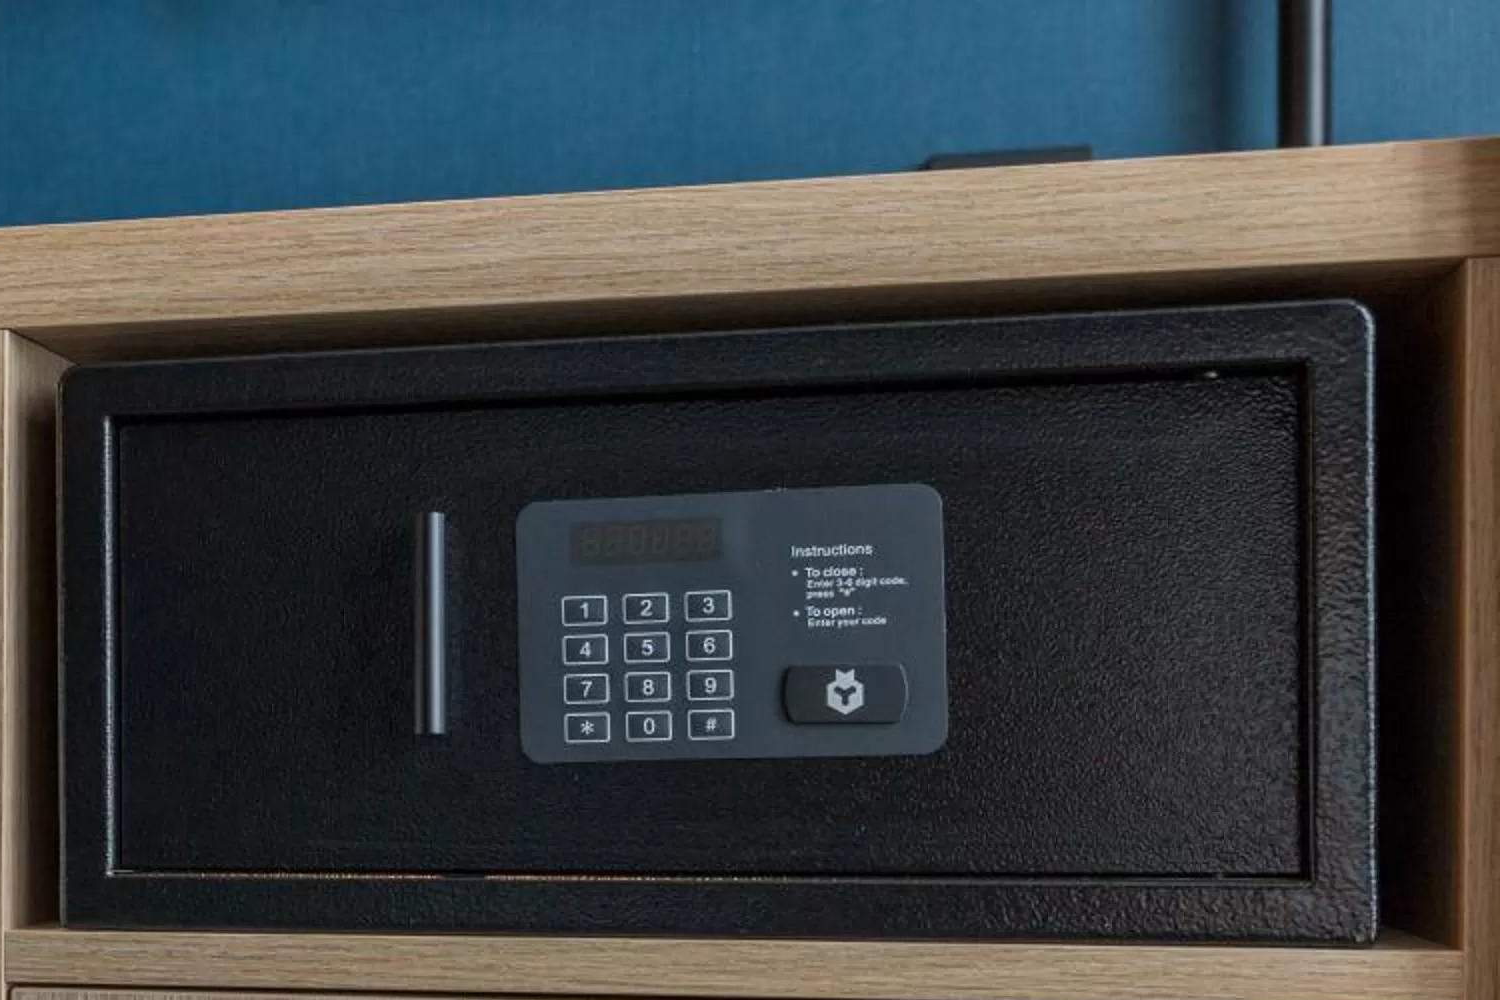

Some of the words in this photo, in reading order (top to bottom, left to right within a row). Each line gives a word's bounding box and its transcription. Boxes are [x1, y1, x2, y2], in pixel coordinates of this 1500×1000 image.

[791, 544, 873, 557] Instructions
[805, 567, 820, 578] To
[579, 602, 589, 619] 1
[640, 599, 653, 617] 2
[702, 596, 715, 614] 3
[805, 605, 821, 617] To
[807, 618, 835, 628] Enter
[861, 617, 887, 626] code
[579, 641, 592, 658] 4
[641, 639, 654, 656] 5
[703, 637, 716, 654] 6
[580, 681, 593, 697] 7
[642, 679, 655, 696] 8
[704, 677, 717, 694] 9
[643, 717, 656, 735] 0
[705, 717, 717, 732] #
